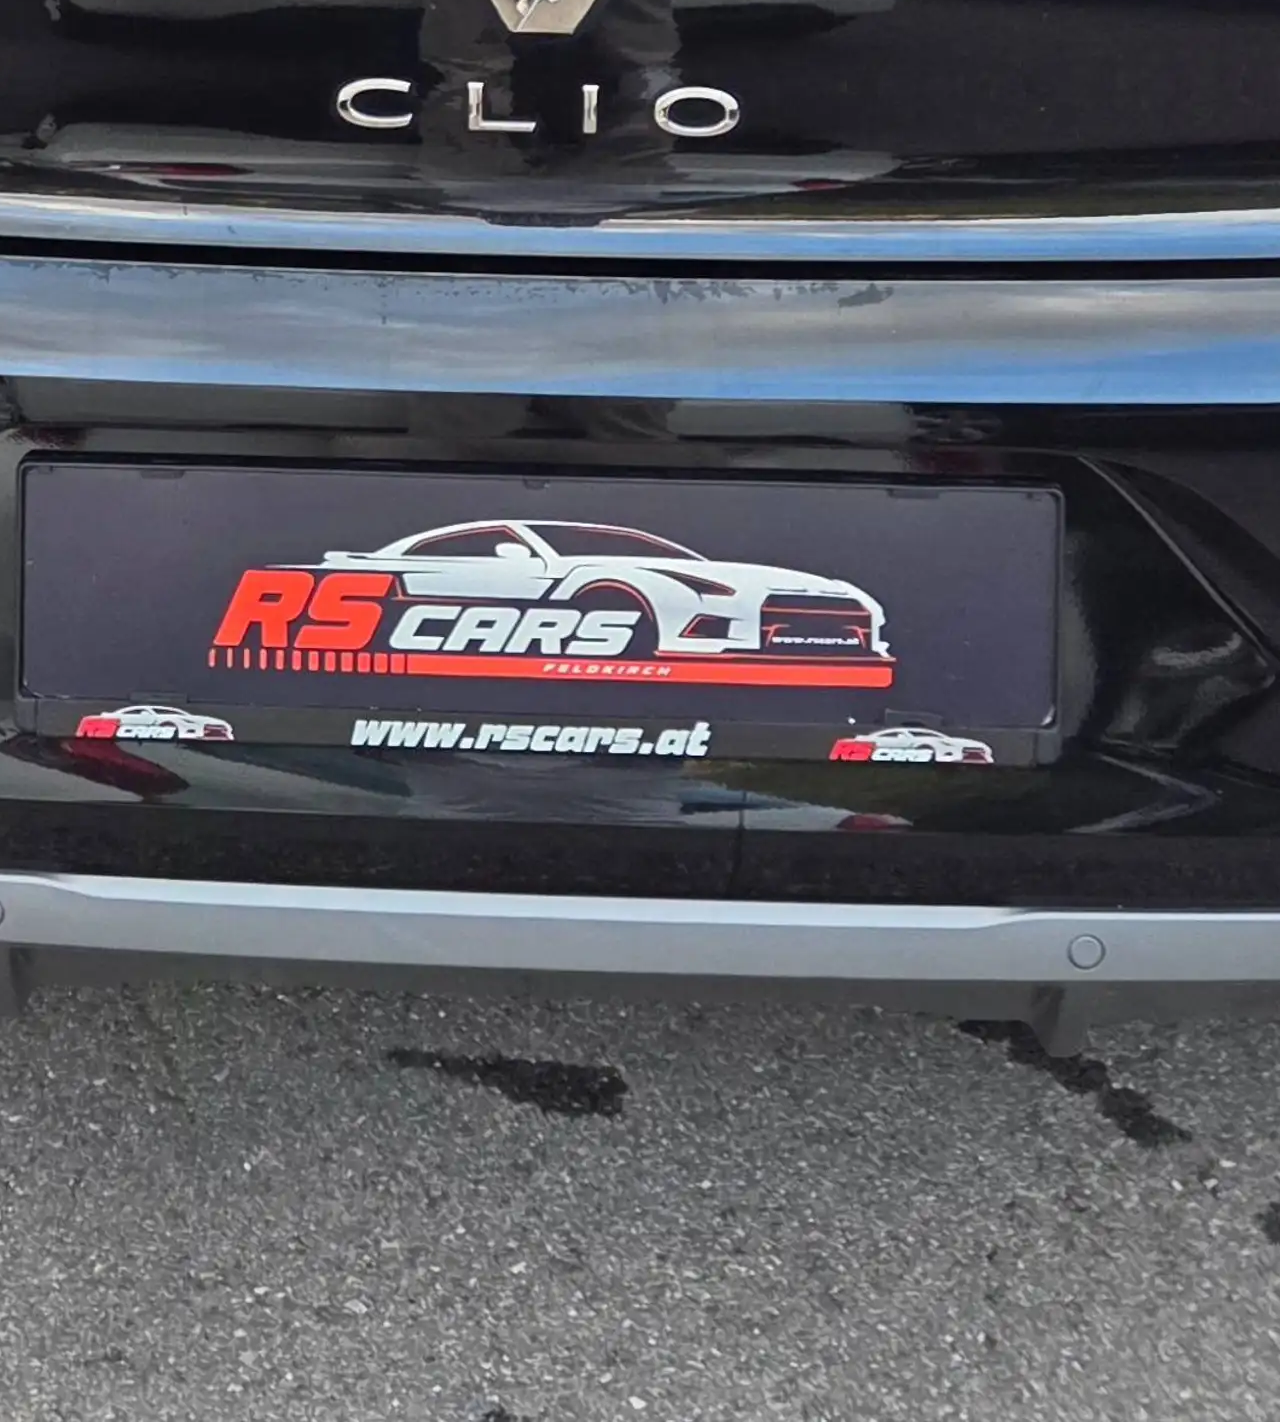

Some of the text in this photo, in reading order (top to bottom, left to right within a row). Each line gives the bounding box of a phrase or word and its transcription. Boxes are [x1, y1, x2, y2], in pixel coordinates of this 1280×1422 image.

[336, 77, 741, 138] CLIO
[213, 569, 642, 656] RS CARS
[542, 662, 672, 677] FELDKIRCH
[116, 725, 178, 740] CARS
[350, 719, 713, 757] www.rscars.at
[871, 748, 934, 763] CARS
